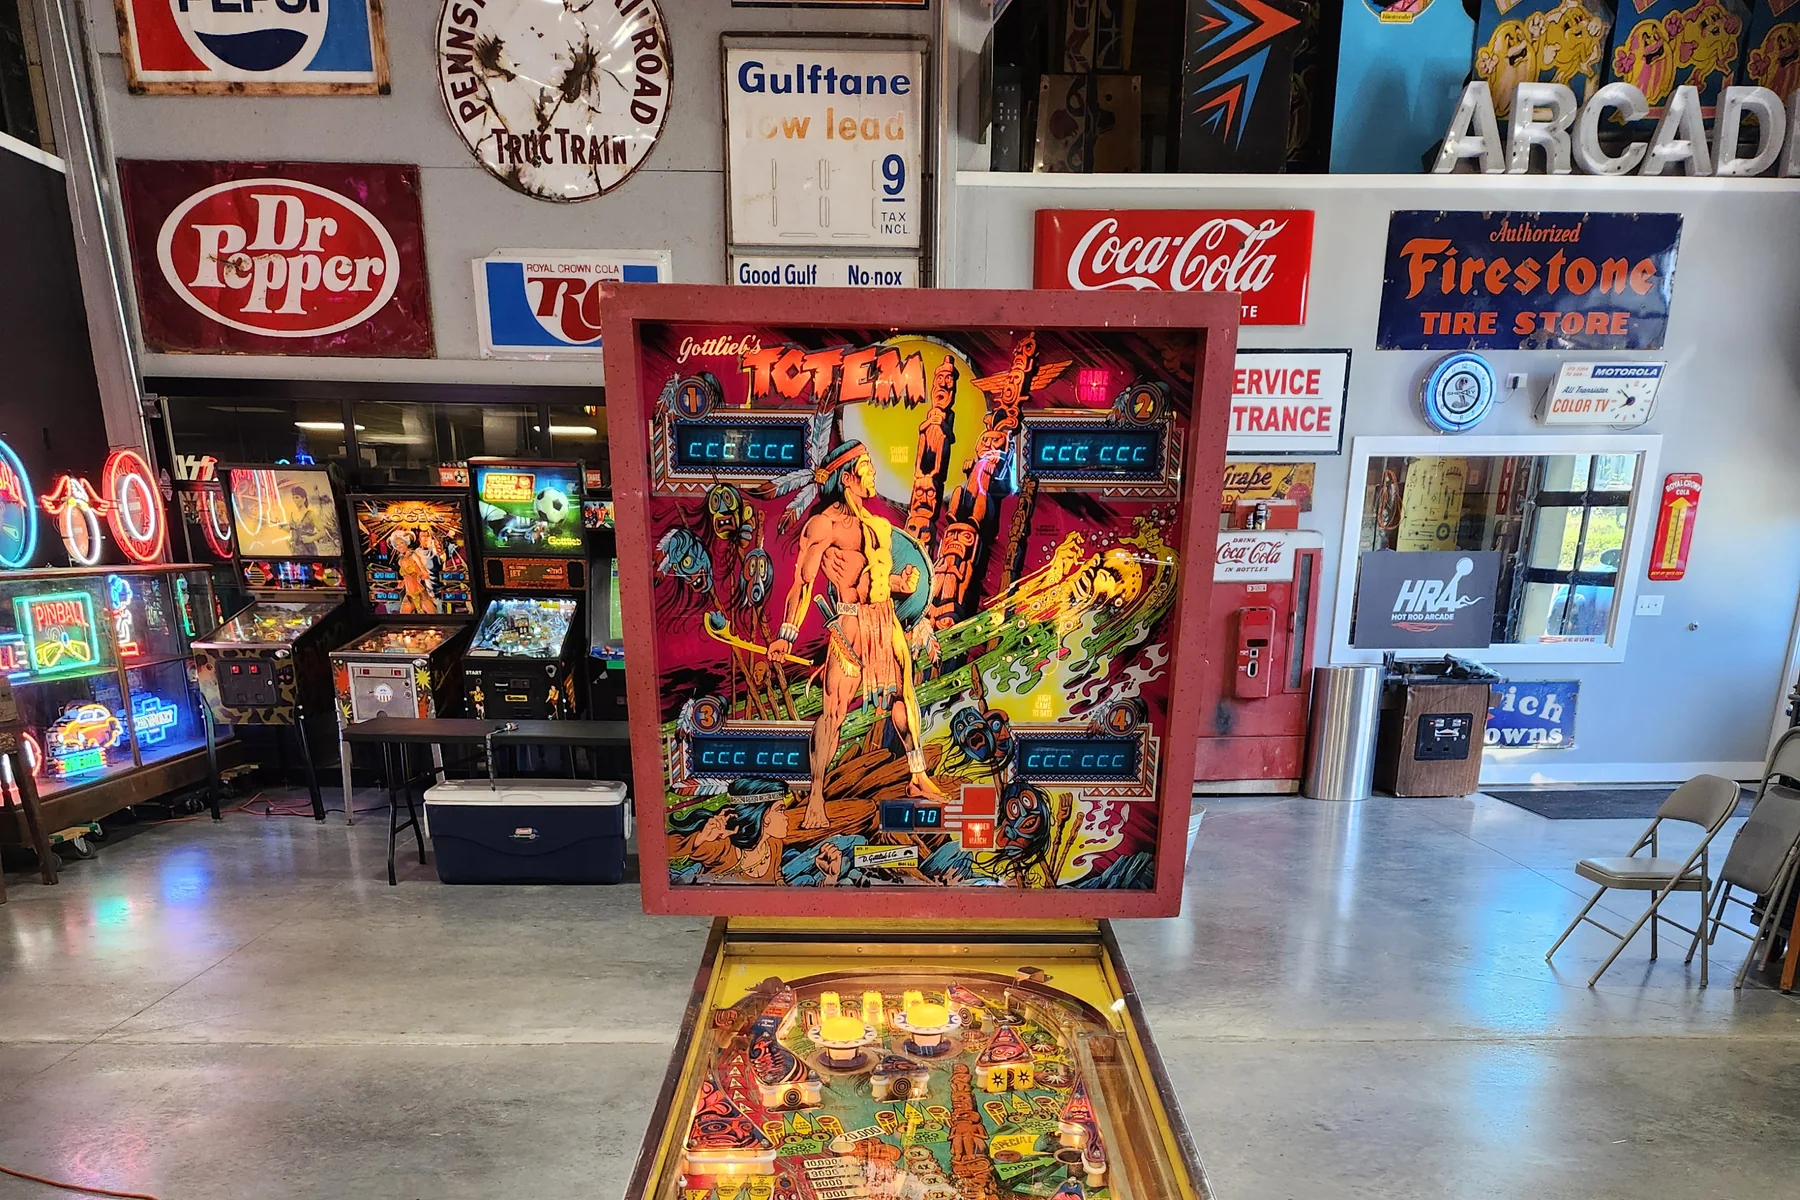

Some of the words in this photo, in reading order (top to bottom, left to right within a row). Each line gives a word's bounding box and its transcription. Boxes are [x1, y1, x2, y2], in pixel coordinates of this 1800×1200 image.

[738, 61, 911, 95] Gulftane
[745, 109, 811, 139] low
[826, 107, 904, 141] lead
[882, 154, 906, 195] 9
[247, 194, 338, 252] Dr
[881, 212, 906, 222] TAX
[880, 225, 910, 234] INCL.
[1490, 221, 1581, 243] Authorized
[1067, 217, 1289, 292] Coca-Cola
[188, 224, 384, 314] Pepper
[526, 264, 555, 273] ROYAL
[558, 264, 591, 273] CROWN
[595, 264, 619, 274] COLA
[739, 263, 780, 285] Good
[784, 264, 817, 285] Gulf
[1400, 238, 1657, 299] Firestone
[1420, 312, 1498, 334] TIRE
[1512, 312, 1630, 335] STORE
[677, 335, 761, 364] Gottlieb's
[743, 346, 926, 404] TOTEM
[1080, 371, 1110, 385] GAME
[1232, 369, 1321, 394] ERVICE
[1594, 367, 1659, 377] MOTOROLA
[687, 388, 697, 413] 1
[1080, 387, 1106, 401] OVER
[1562, 385, 1575, 394] All
[1576, 386, 1609, 394] Transistor
[1136, 393, 1151, 418] 2
[1552, 399, 1591, 413] COLOR
[1595, 399, 1610, 412] TV
[1232, 406, 1332, 432] TRANCE
[890, 455, 908, 463] AGAIN
[1665, 479, 1683, 492] ROYAL
[548, 536, 582, 546] Gottlieb
[35, 601, 89, 632] PINBALL
[1391, 613, 1407, 621] HOT
[1407, 613, 1424, 621] ROD
[1501, 686, 1563, 723] ich
[701, 705, 714, 727] 3
[1112, 709, 1128, 731] 4
[840, 1127, 882, 1142] 20,000
[992, 1135, 1033, 1151] SPECIAL
[821, 1190, 848, 1199] 7000
